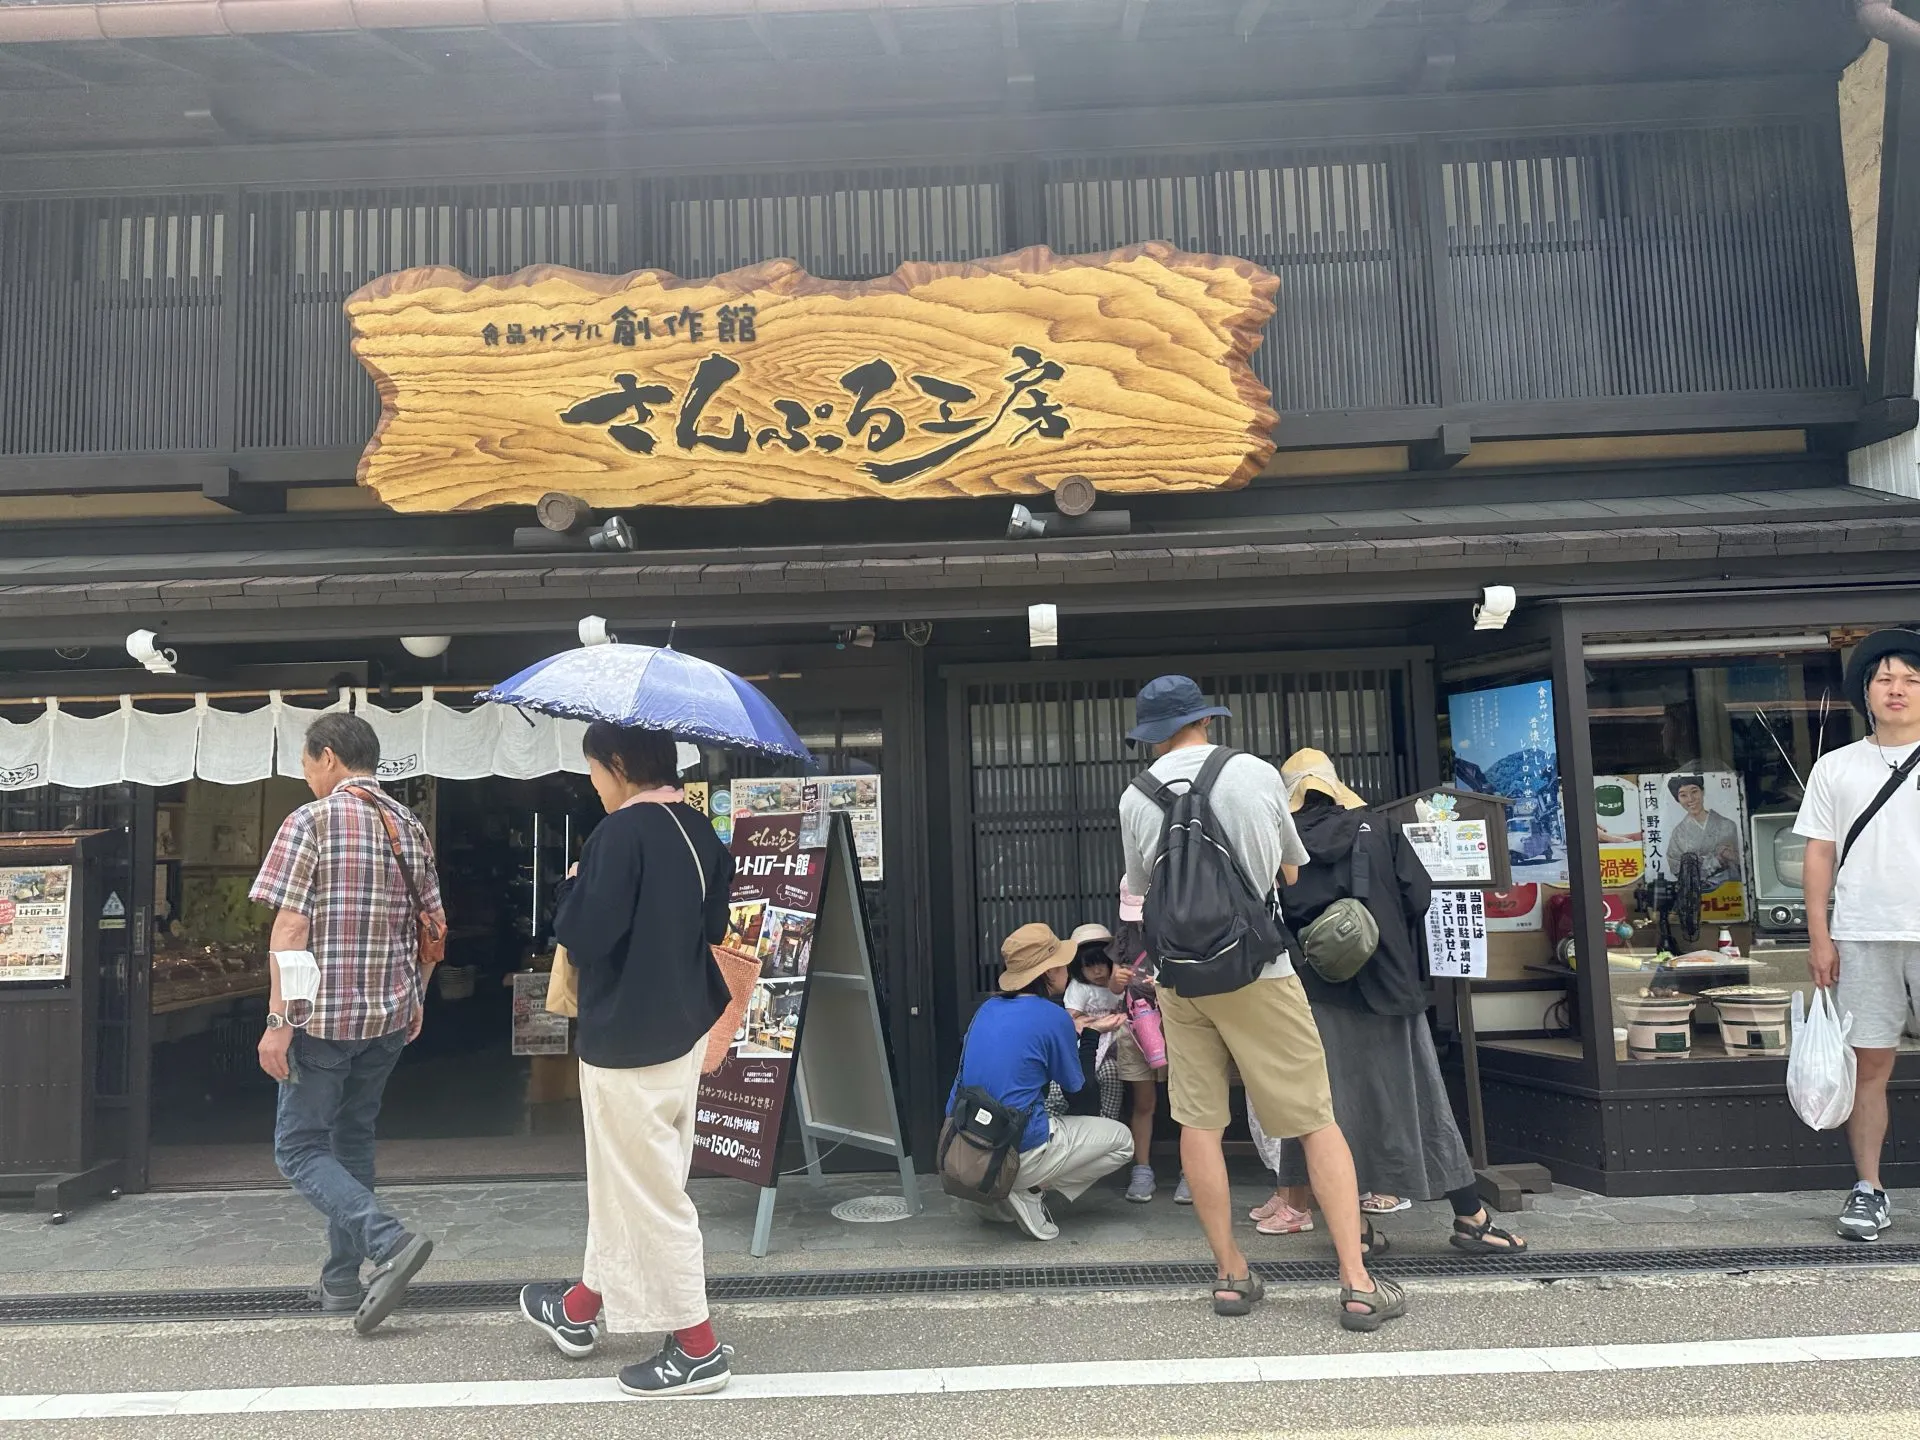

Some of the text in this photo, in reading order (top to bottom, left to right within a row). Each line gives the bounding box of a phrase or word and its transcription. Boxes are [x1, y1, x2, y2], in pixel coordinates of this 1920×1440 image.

[561, 346, 1070, 484] さんぷる工房
[1537, 685, 1554, 773] 食品サンプルと
[734, 853, 811, 876] レトロアート館
[1647, 815, 1663, 873] 野菜入り
[1441, 891, 1457, 962] ございません
[1455, 891, 1471, 975] 専用の駐車場は
[1470, 891, 1484, 939] 当館には
